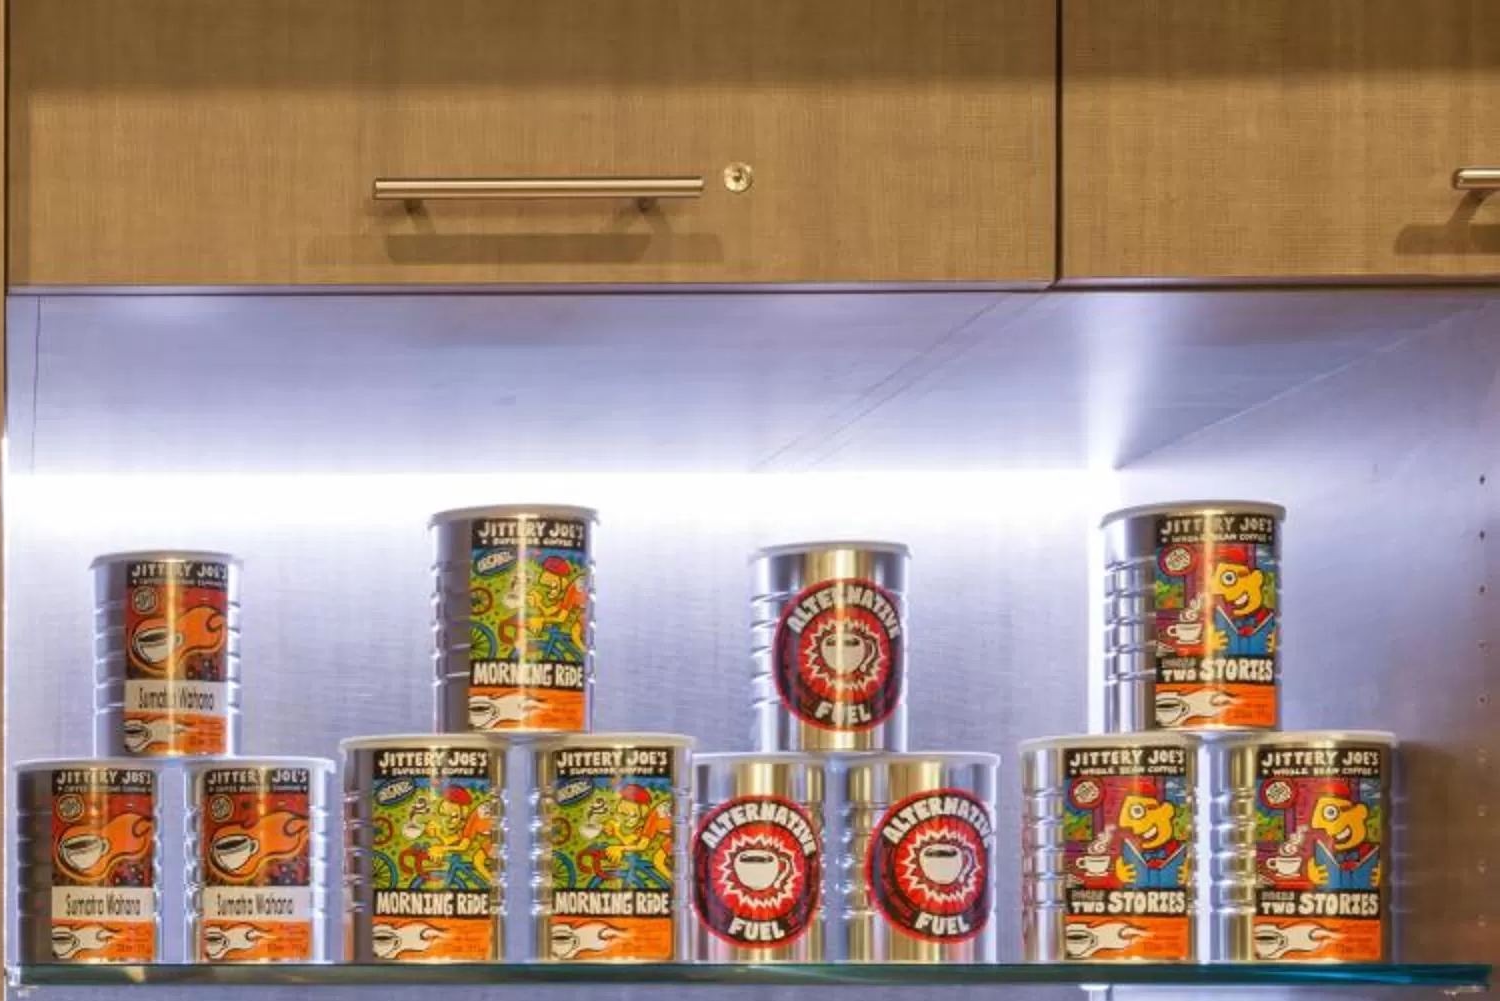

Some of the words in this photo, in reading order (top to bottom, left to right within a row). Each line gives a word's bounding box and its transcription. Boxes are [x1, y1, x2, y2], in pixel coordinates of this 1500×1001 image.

[479, 521, 546, 538] JITTRY
[1161, 517, 1236, 535] JITTRY
[131, 563, 192, 578] JITTRY
[1164, 669, 1196, 683] TWO
[1200, 658, 1273, 682] STORIES
[138, 687, 177, 709] Sumata
[815, 701, 872, 724] FUEL
[379, 751, 444, 767] JITTERY
[448, 751, 488, 767] JOE'S
[557, 751, 622, 767] JITTERY
[626, 751, 667, 767] JOE'S
[1070, 750, 1144, 767] JITTERY
[1148, 750, 1185, 765] JOE'S
[1261, 751, 1337, 767] JITTERY
[1342, 751, 1380, 766] JOE'S
[271, 769, 307, 783] JOE'S
[701, 801, 817, 856] ALTERNATIVE
[106, 893, 141, 916] Wahana
[376, 891, 454, 916] MORNING
[555, 891, 634, 916] MORNING
[1071, 901, 1104, 915] TWO
[1107, 891, 1186, 915] STORIES
[1261, 901, 1295, 916] TWO
[1299, 893, 1379, 916] STORIES
[728, 917, 785, 941] FUEL
[915, 912, 970, 934] FUEL
